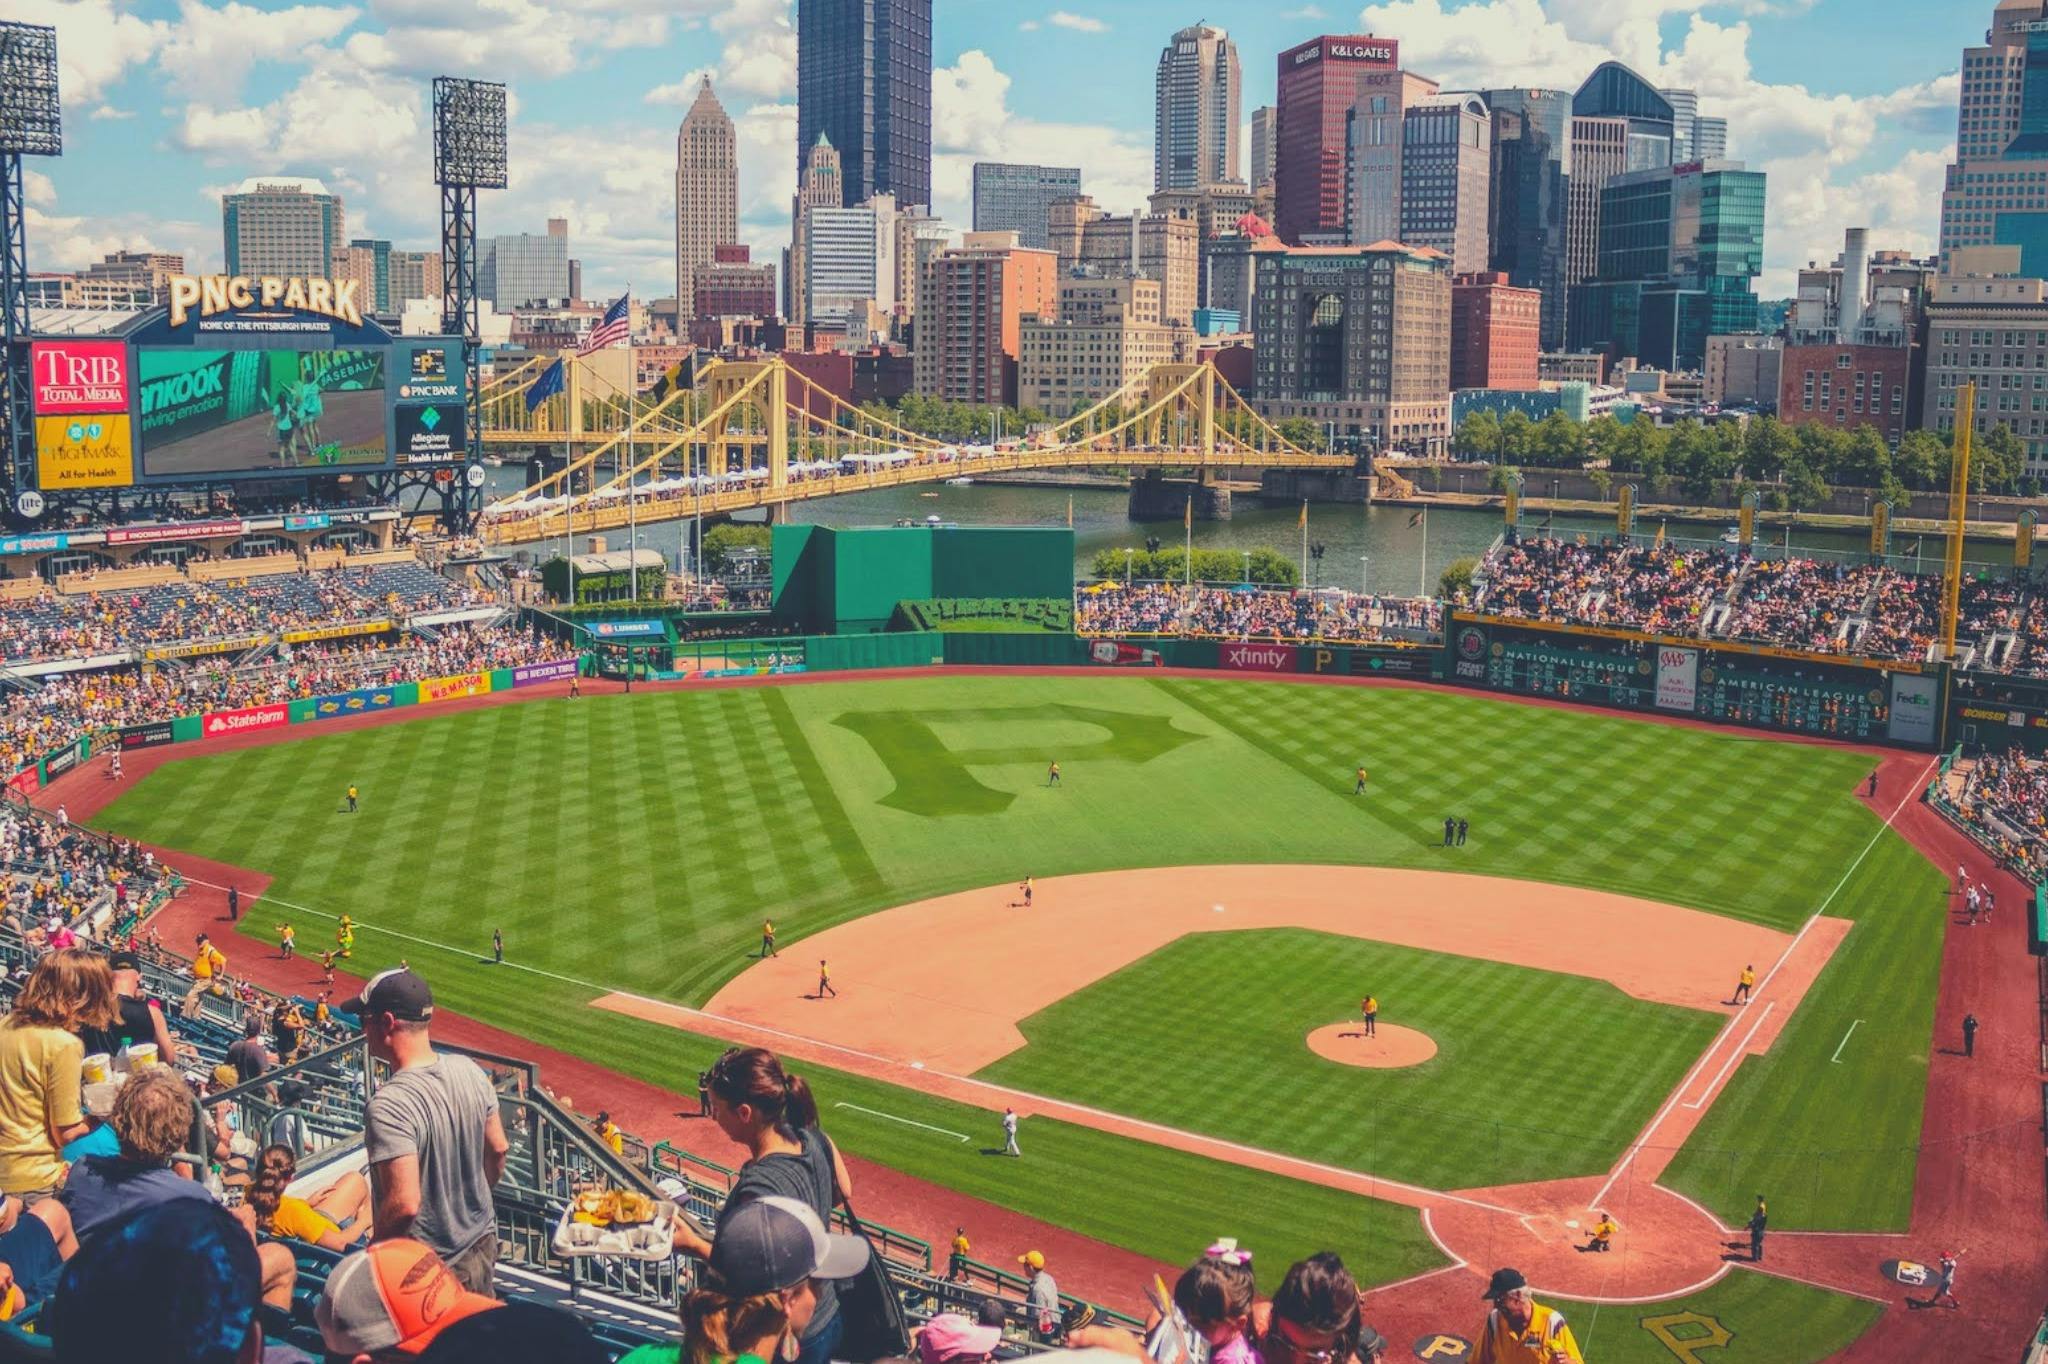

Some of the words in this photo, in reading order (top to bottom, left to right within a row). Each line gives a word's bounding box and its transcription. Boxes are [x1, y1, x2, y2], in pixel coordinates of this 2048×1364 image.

[1331, 45, 1352, 56] K&L
[1354, 46, 1391, 59] GATES
[1366, 74, 1392, 85] EQT
[168, 273, 255, 327] PNC
[260, 275, 364, 328] PARK
[200, 322, 223, 331] HOME
[224, 322, 236, 331] OF
[237, 322, 252, 331] THE
[252, 322, 300, 331] PITTSBURGH
[300, 322, 331, 332] PIRATES
[38, 350, 121, 386] TRIB
[40, 386, 83, 402] TOTAL
[84, 386, 123, 401] MEDIA
[411, 386, 432, 396] PNC
[432, 386, 458, 396] BANK
[411, 433, 450, 444] Allegheny
[51, 446, 121, 461] HIGHMARK
[408, 453, 431, 463] Health
[432, 453, 442, 462] for
[443, 452, 453, 461] All
[59, 471, 72, 479] All
[73, 470, 86, 479] for
[88, 468, 117, 477] Health
[21, 498, 42, 511] Lite
[188, 527, 201, 535] OUT
[614, 624, 650, 632] LUMBER
[1229, 647, 1287, 669] xfinity
[1315, 650, 1332, 672] P
[1506, 650, 1575, 667] NATIONAL
[1581, 660, 1635, 675] LEAGUE
[1661, 651, 1686, 667] AAA
[1717, 678, 1798, 695] AMERICAN
[1803, 687, 1865, 704] LEAGUE
[1964, 707, 2007, 722] BOWSER
